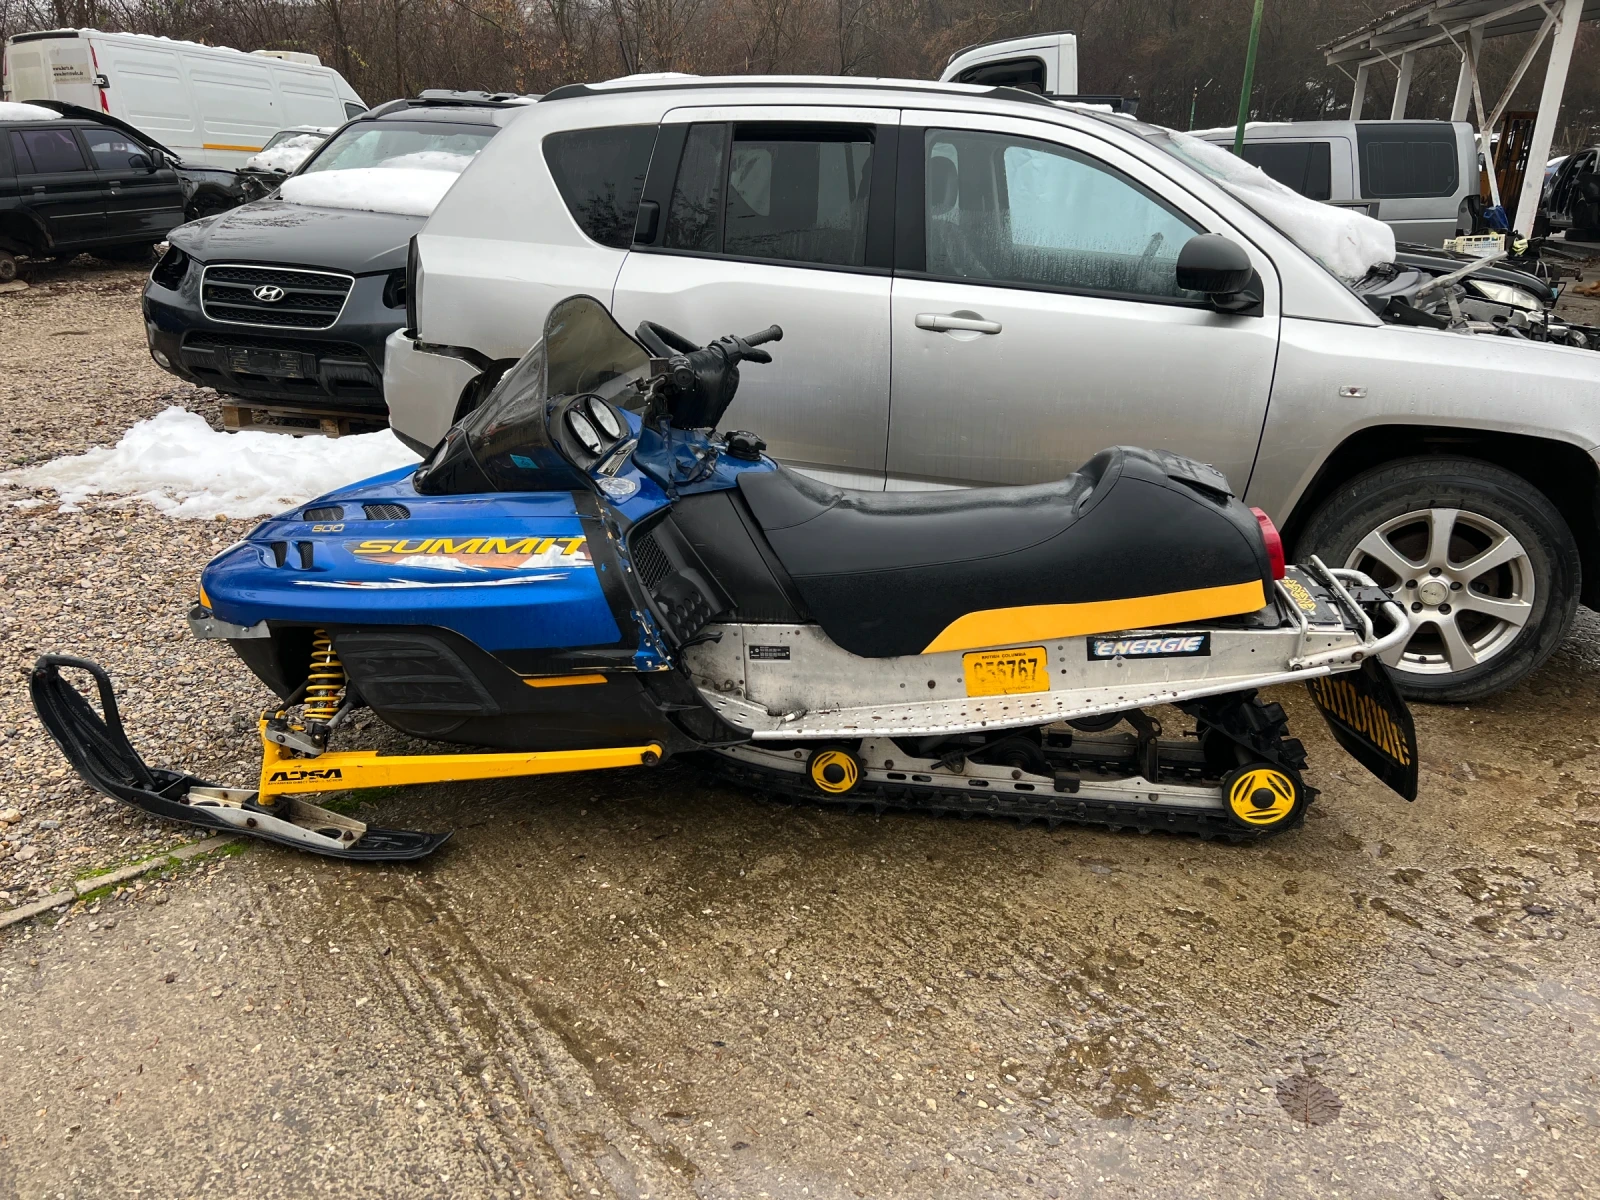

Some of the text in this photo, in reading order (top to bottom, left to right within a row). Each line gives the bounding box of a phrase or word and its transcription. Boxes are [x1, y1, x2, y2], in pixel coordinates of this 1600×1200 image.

[311, 523, 345, 533] 600
[353, 537, 587, 555] SUMMIT
[1096, 636, 1204, 656] ENERGIE
